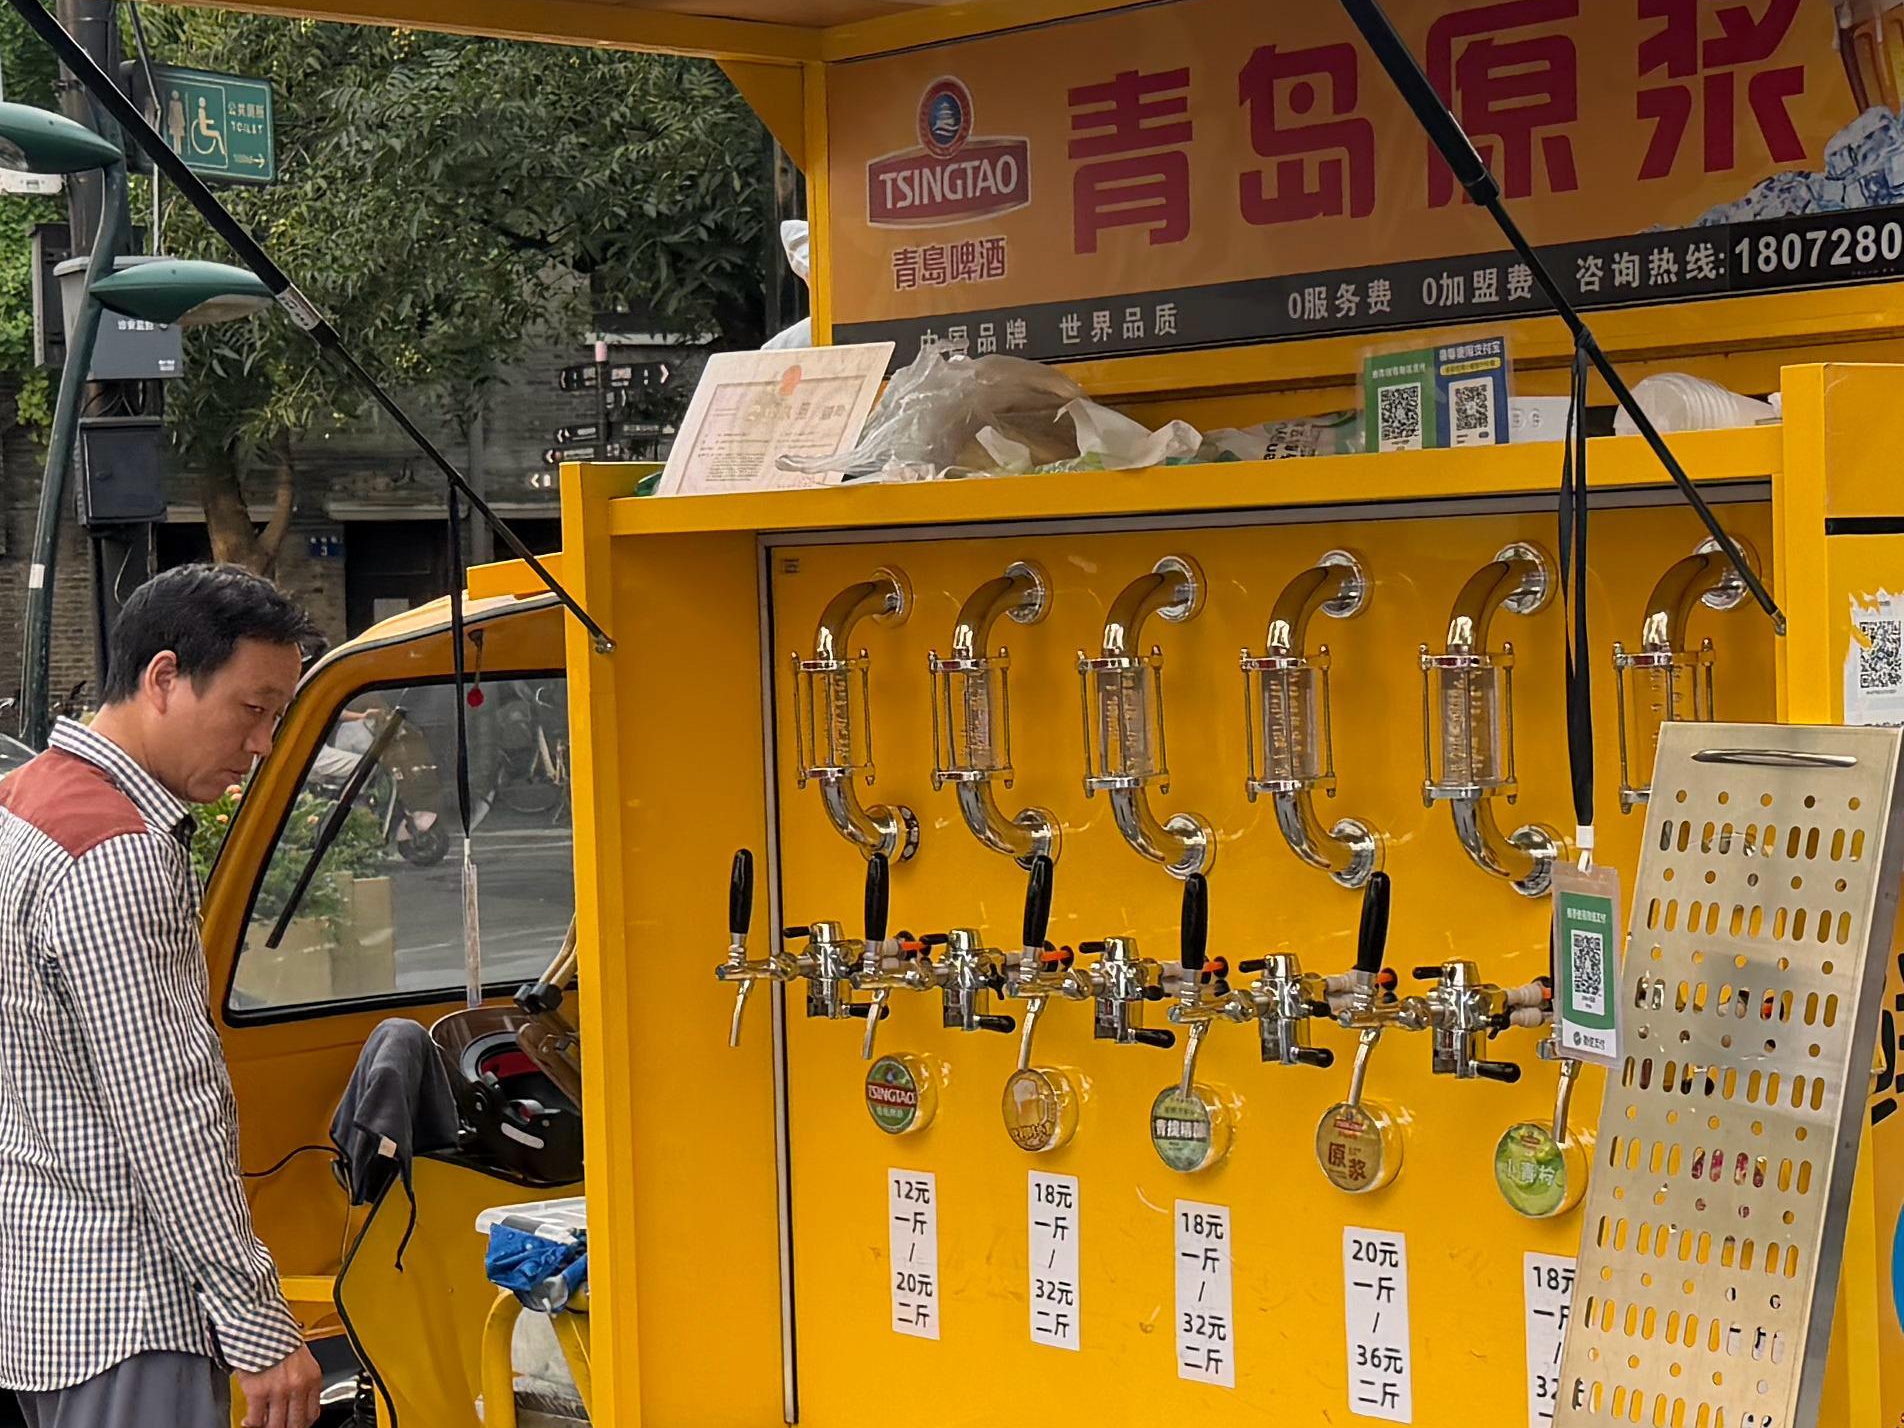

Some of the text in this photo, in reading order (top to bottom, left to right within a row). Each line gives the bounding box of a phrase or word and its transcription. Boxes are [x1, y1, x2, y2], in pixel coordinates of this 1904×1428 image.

[879, 155, 1018, 209] TSINGTAO
[920, 317, 1029, 359] 中国品牌
[1059, 302, 1178, 346] 世界品质
[1287, 278, 1393, 321] 0服务费
[893, 1179, 930, 1204] 12元
[1034, 1182, 1072, 1209] 18元
[894, 1211, 927, 1235] 一斤
[1034, 1216, 1069, 1241] 一斤
[1181, 1212, 1224, 1240] 18元
[1181, 1248, 1220, 1273] 一斤
[1352, 1239, 1399, 1268] 20元
[896, 1271, 933, 1297] 20元
[1035, 1278, 1073, 1307] 32元
[1353, 1276, 1396, 1303] 一斤
[897, 1302, 931, 1328] 二斤
[1036, 1310, 1072, 1338] 二斤
[1183, 1312, 1227, 1341] 32元
[1184, 1345, 1223, 1375] 二斤
[1356, 1344, 1403, 1375] 36元
[1358, 1379, 1400, 1409] 二斤
